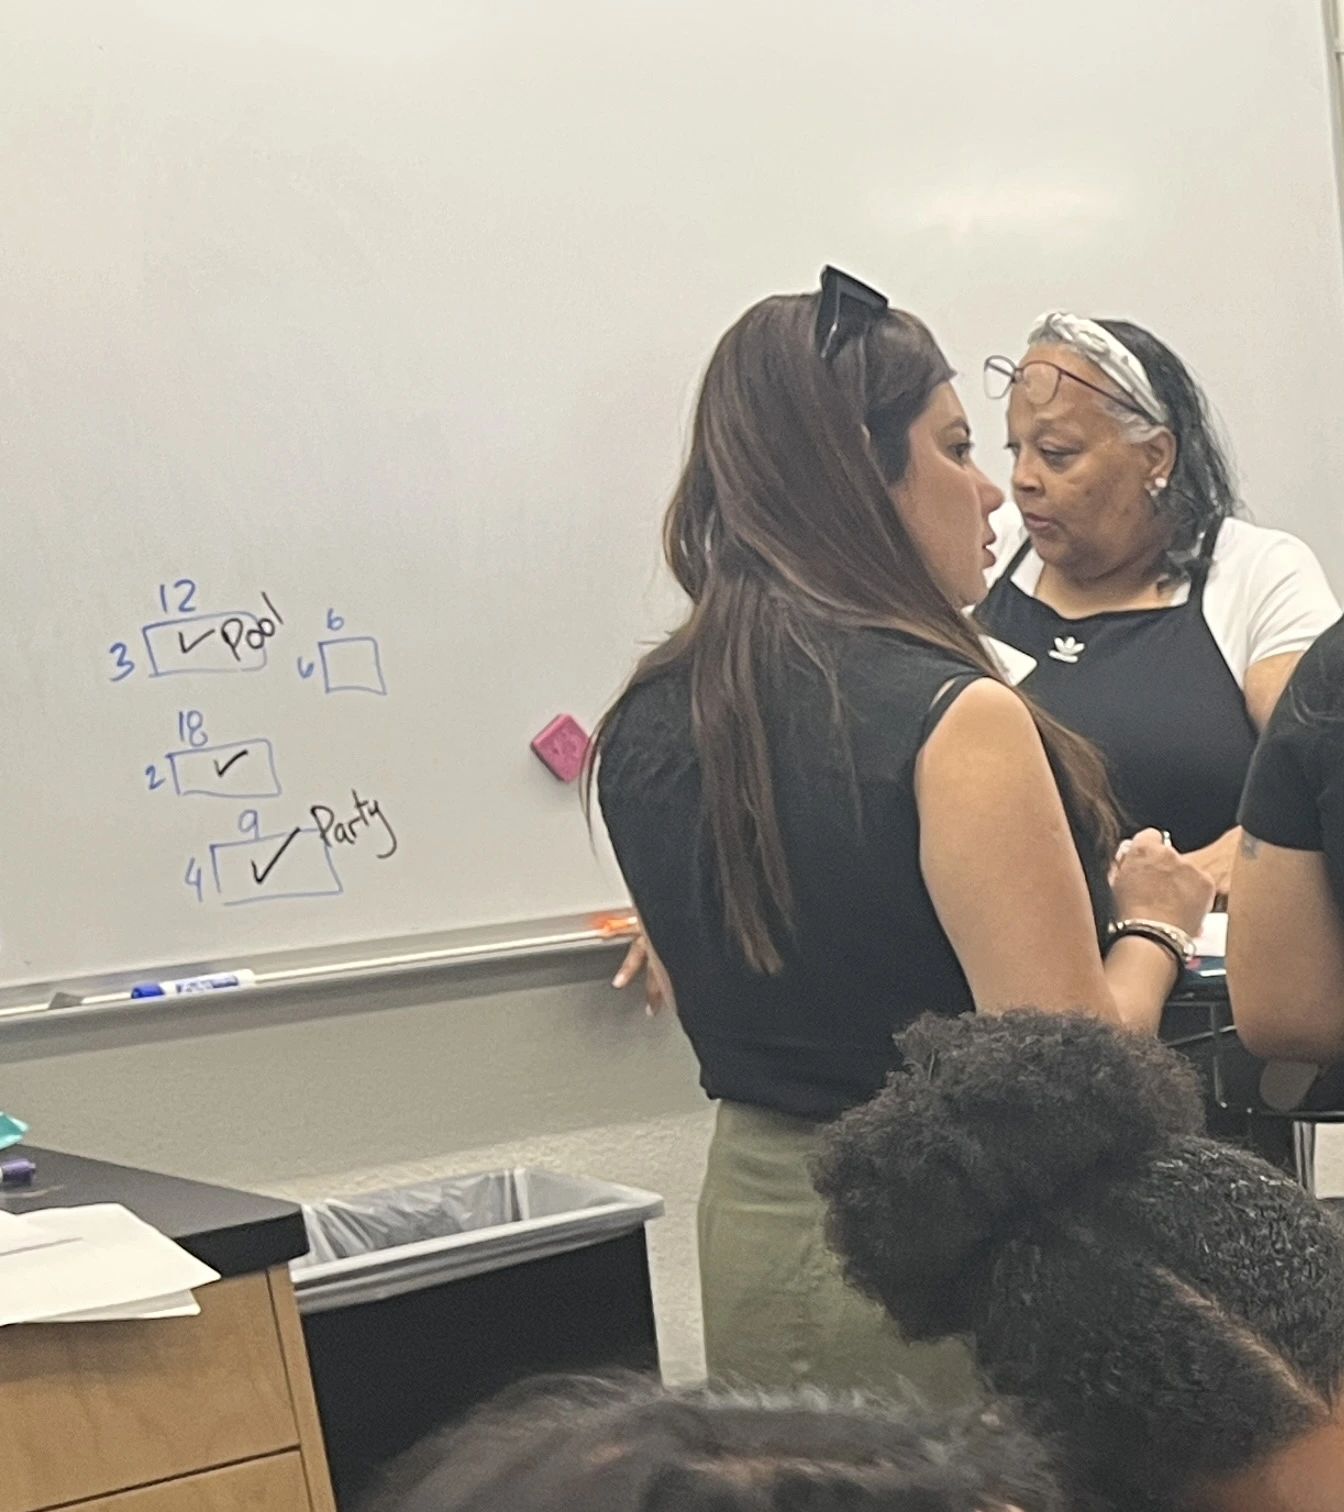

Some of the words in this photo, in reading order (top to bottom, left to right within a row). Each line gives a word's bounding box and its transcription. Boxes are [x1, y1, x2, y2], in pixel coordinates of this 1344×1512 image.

[160, 579, 196, 614] 12
[221, 591, 284, 662] Pool
[327, 608, 344, 631] 6
[109, 642, 135, 681] 3
[179, 710, 208, 747] 18
[145, 765, 165, 790] 2
[238, 809, 261, 840] 9
[310, 789, 397, 859] Party
[185, 857, 203, 902] 4
